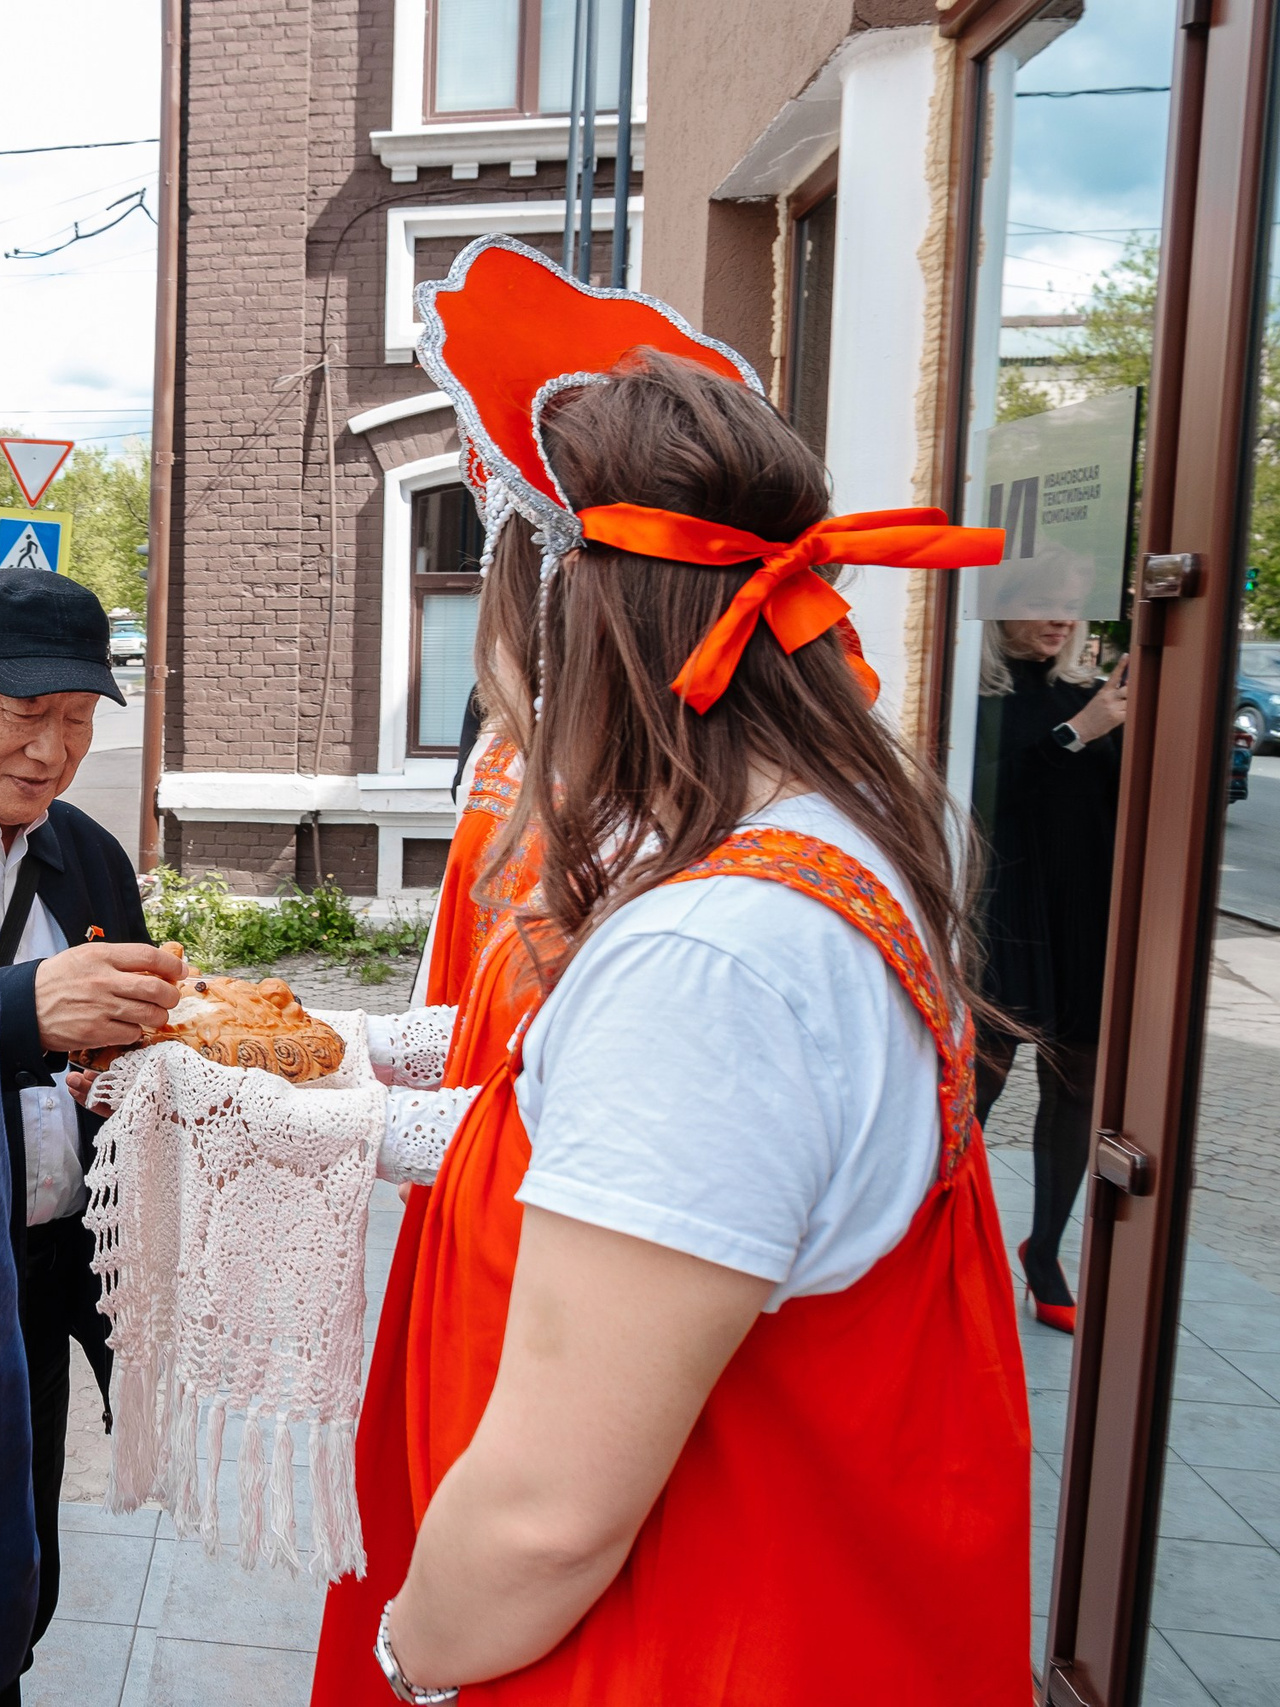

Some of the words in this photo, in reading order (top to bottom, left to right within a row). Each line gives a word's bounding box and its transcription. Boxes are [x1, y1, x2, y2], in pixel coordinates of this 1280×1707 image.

[1044, 465, 1100, 488] ИВАНОВСКАЯ
[1043, 484, 1101, 506] ТЕКСТИЛЬНАЯ
[1042, 505, 1088, 525] КОМПАНИЯ
